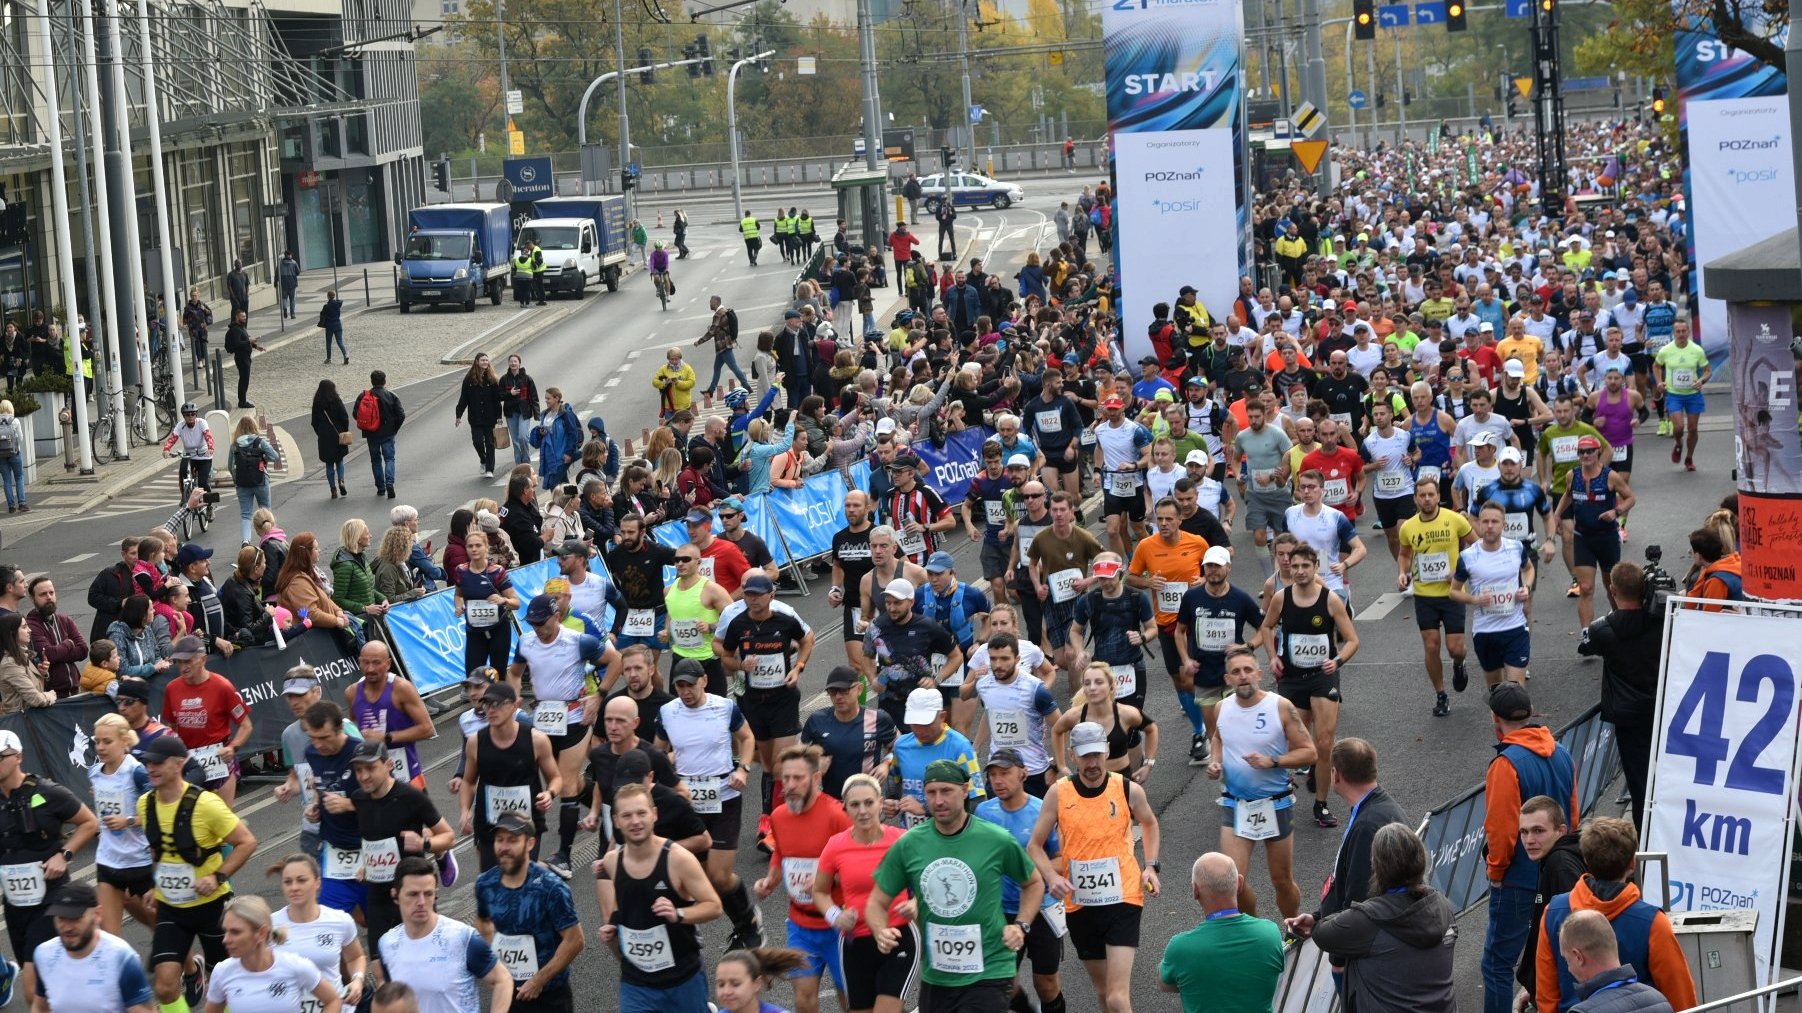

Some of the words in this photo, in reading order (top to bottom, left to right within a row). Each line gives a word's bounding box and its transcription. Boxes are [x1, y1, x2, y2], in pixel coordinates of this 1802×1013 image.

[1124, 70, 1217, 96] START
[1146, 139, 1201, 149] Organizatorzy
[1769, 370, 1793, 406] E
[1114, 481, 1132, 490] 3291
[1381, 477, 1402, 486] 1237
[1324, 486, 1345, 498] 2186
[1425, 529, 1451, 539] SQUAD
[1422, 560, 1447, 573] 3639
[1763, 564, 1796, 582] POZNAŃ
[471, 608, 496, 618] 3335
[628, 617, 653, 627] 3648
[1206, 630, 1227, 639] 3813
[1294, 644, 1327, 656] 2408
[537, 711, 564, 723] 2839
[1255, 712, 1267, 730] 5
[1665, 650, 1795, 796] 42
[996, 721, 1018, 735] 278
[492, 798, 528, 811] 3364
[1682, 798, 1752, 856] km
[337, 850, 360, 865] 957
[7, 875, 38, 892] 3121
[159, 876, 191, 890] 2329
[1077, 871, 1116, 890] 2341
[627, 940, 665, 957] 2599
[934, 939, 975, 956] 1099
